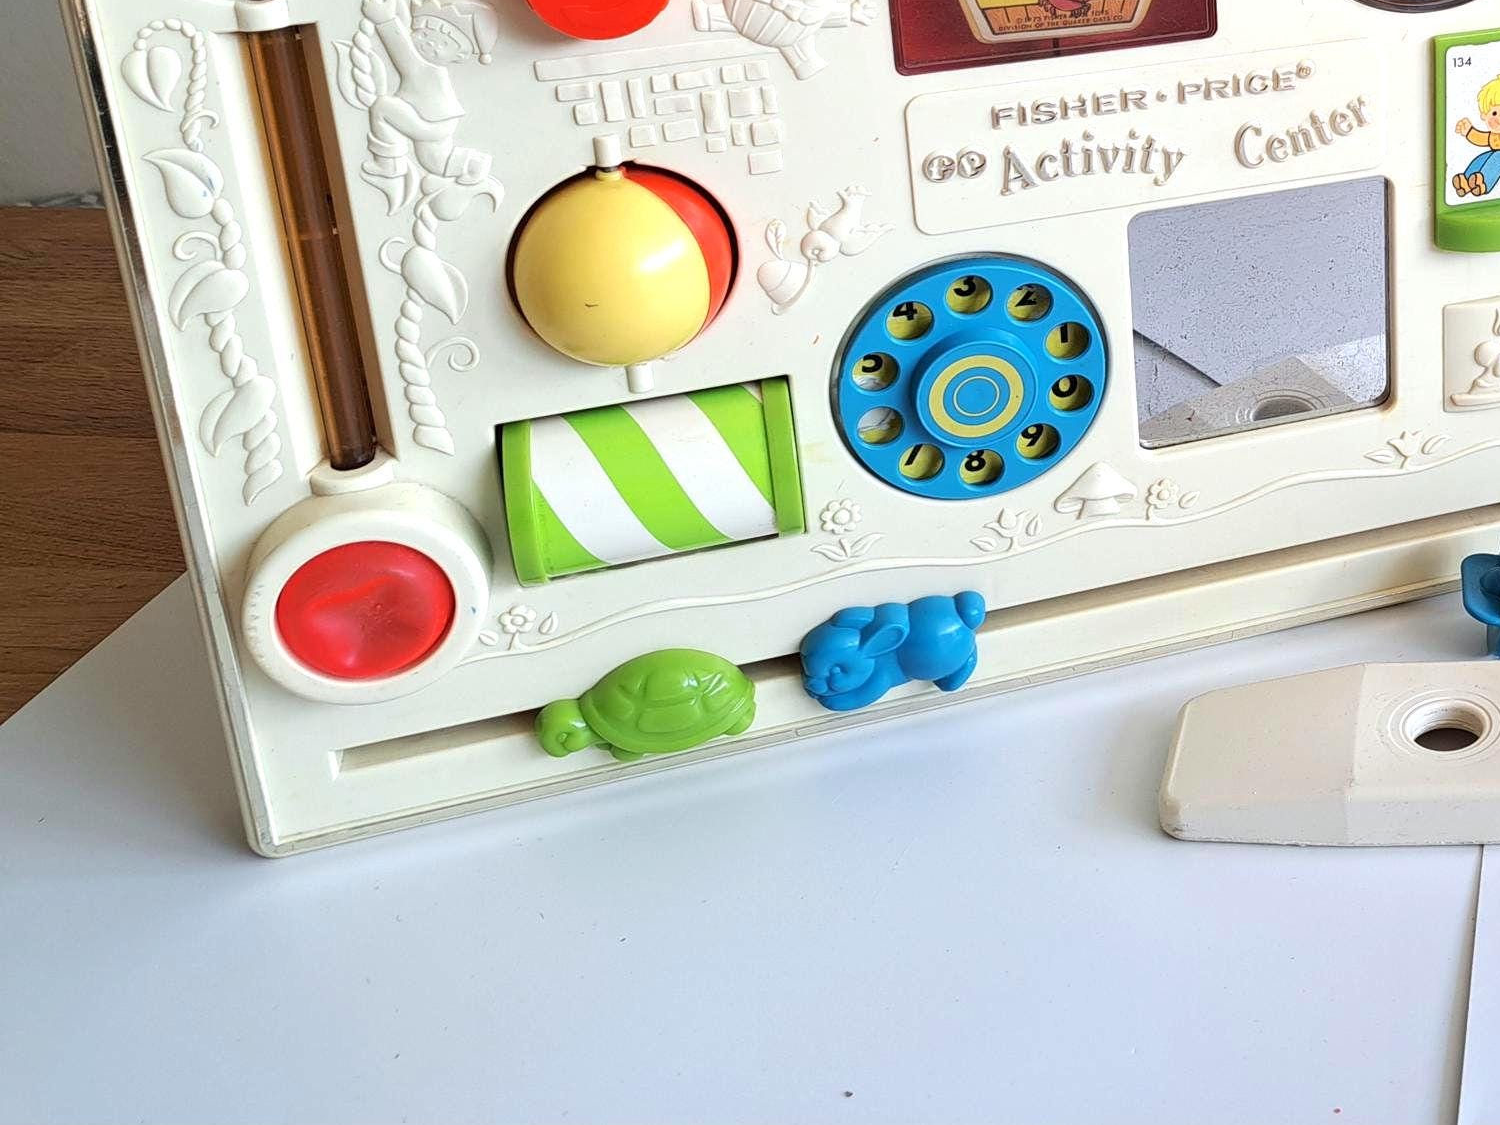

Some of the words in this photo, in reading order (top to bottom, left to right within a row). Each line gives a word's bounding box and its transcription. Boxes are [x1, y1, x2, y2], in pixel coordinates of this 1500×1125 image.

[1452, 57, 1472, 68] 134
[1000, 127, 1188, 196] Activity
[1234, 93, 1373, 170] Center
